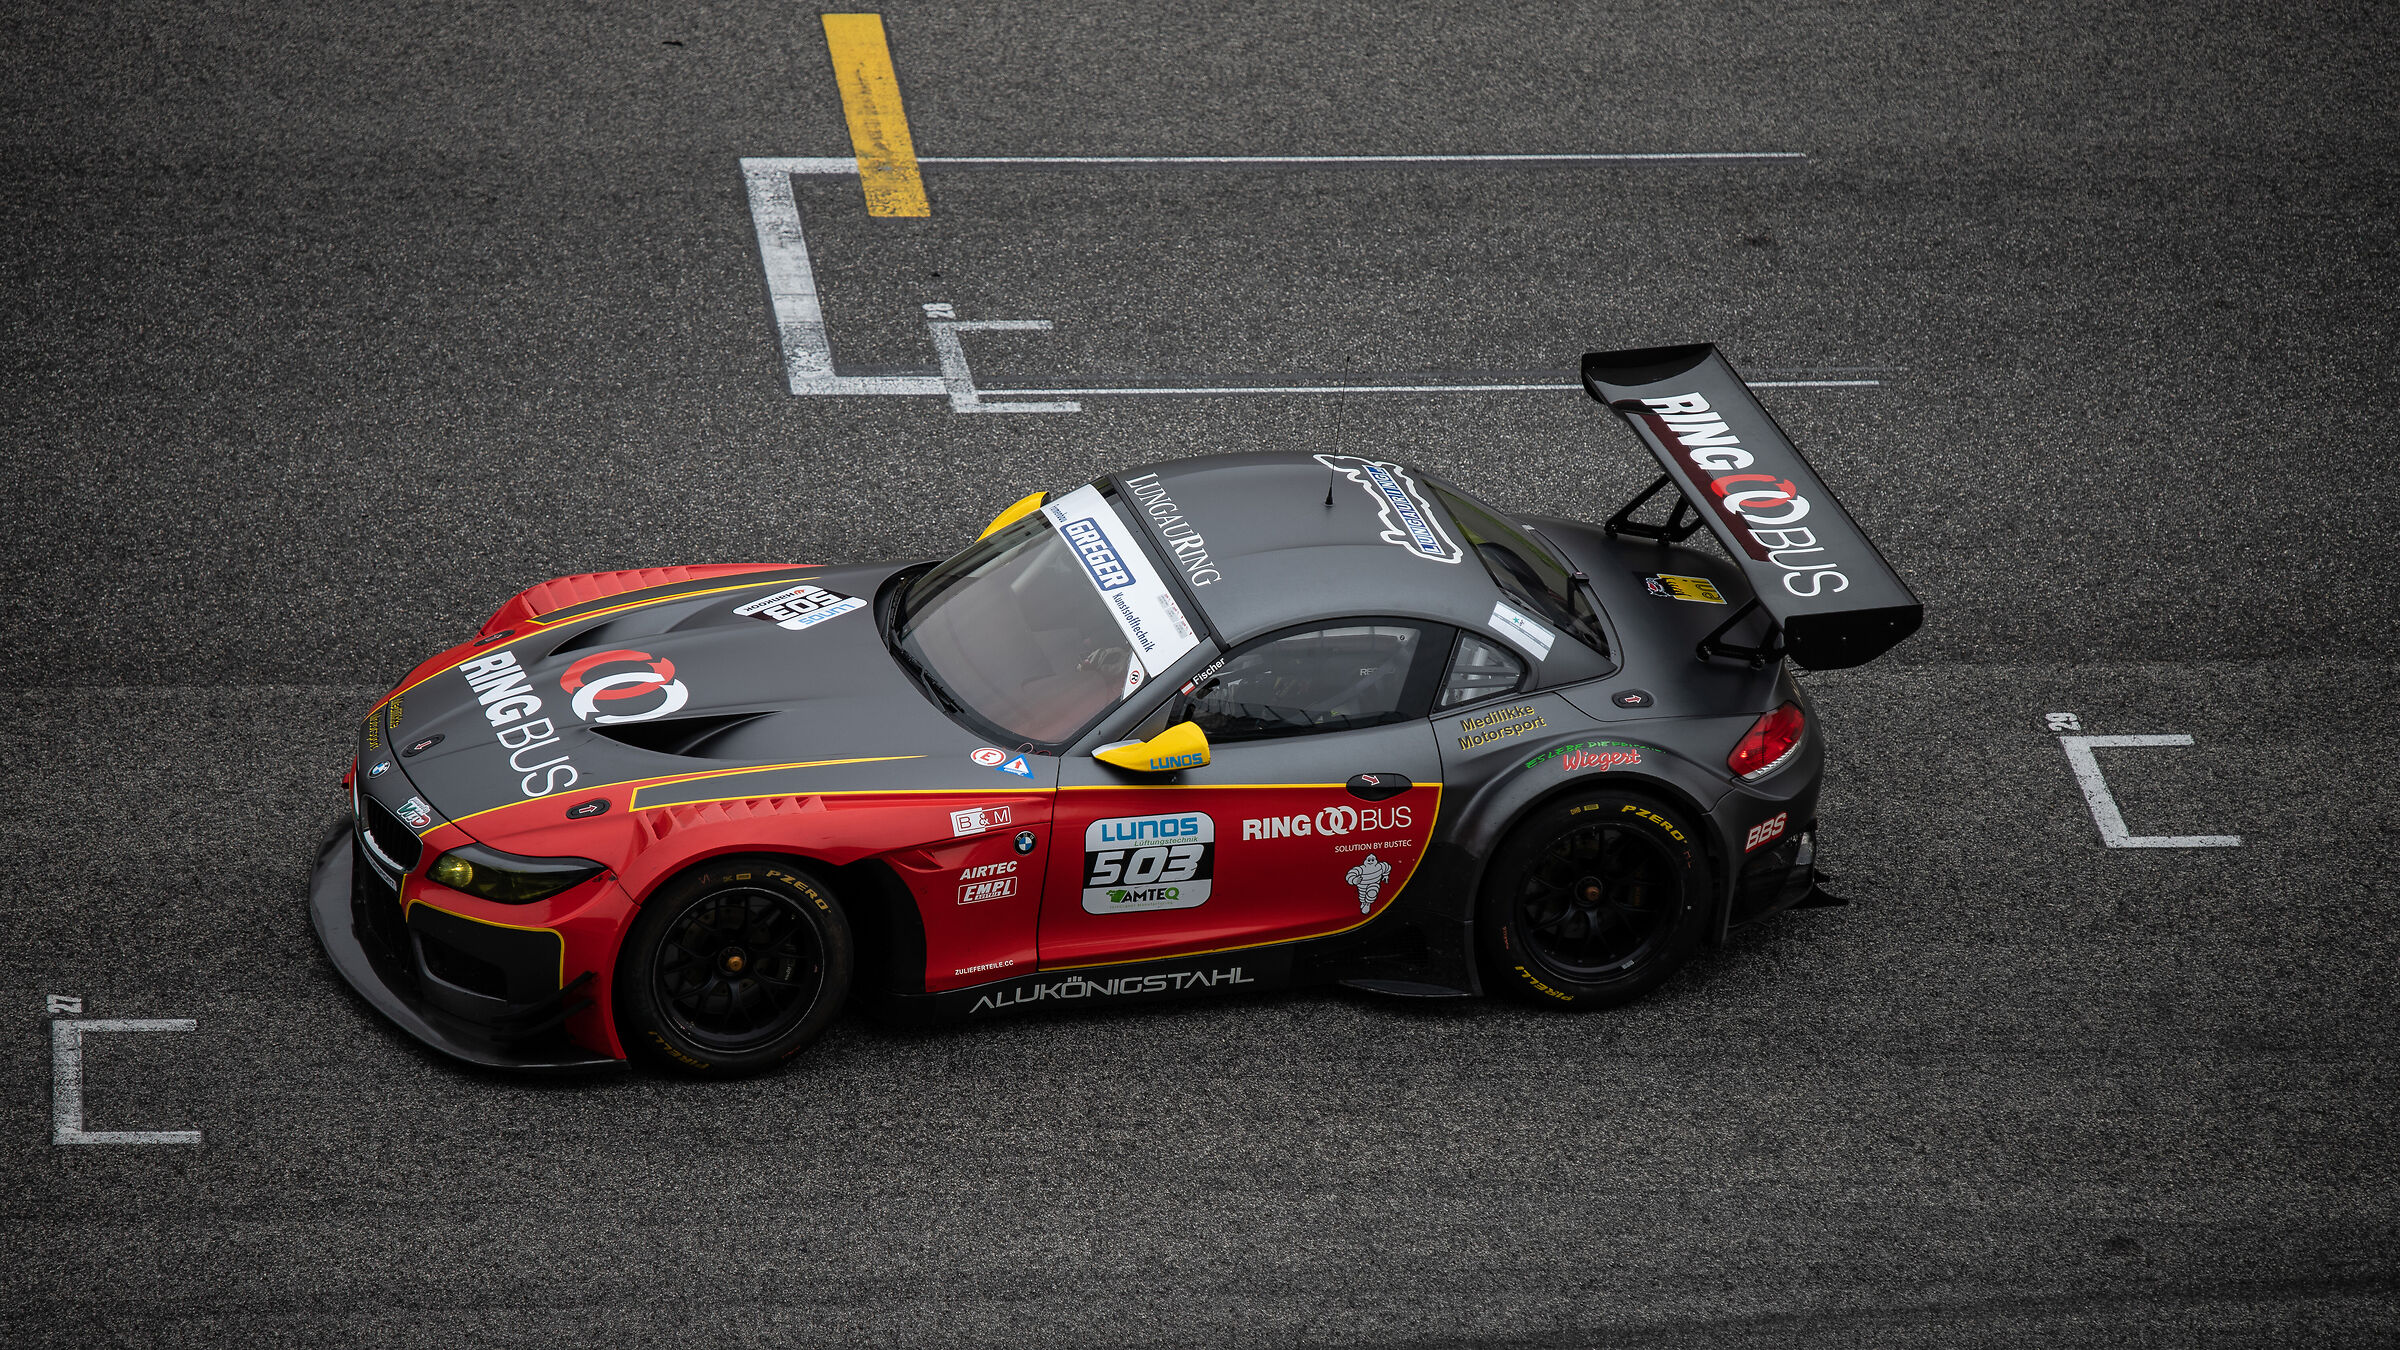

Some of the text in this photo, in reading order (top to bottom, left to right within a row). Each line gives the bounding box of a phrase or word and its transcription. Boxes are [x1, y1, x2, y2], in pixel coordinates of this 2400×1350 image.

[1640, 391, 1849, 597] RING BUS
[1065, 519, 1130, 589] GREGER
[762, 590, 843, 621] 503
[1112, 591, 1155, 653] Kunststofftechnik
[1192, 657, 1225, 685] Fischer
[1460, 704, 1535, 732] Medilikke
[1457, 715, 1547, 751] Motorsport
[980, 751, 997, 762] E
[1150, 753, 1203, 770] LUNOS
[1562, 748, 1641, 772] Wiegert
[959, 816, 971, 829] B
[994, 809, 1009, 824] M
[1101, 817, 1198, 842] LUNOS
[1242, 806, 1412, 841] RING BUS
[1745, 812, 1787, 850] BBS
[1134, 836, 1199, 847] Lüftungstechnik
[1334, 839, 1412, 853] SOLUTION BY BUSTEC
[960, 861, 1018, 880] AIRTEC
[1089, 843, 1205, 886] 503
[963, 879, 1012, 902] EMPL
[954, 959, 1014, 976] ZULIEFERTEILE.CC
[968, 967, 1255, 1014] ALUKÖNIGSTAHL
